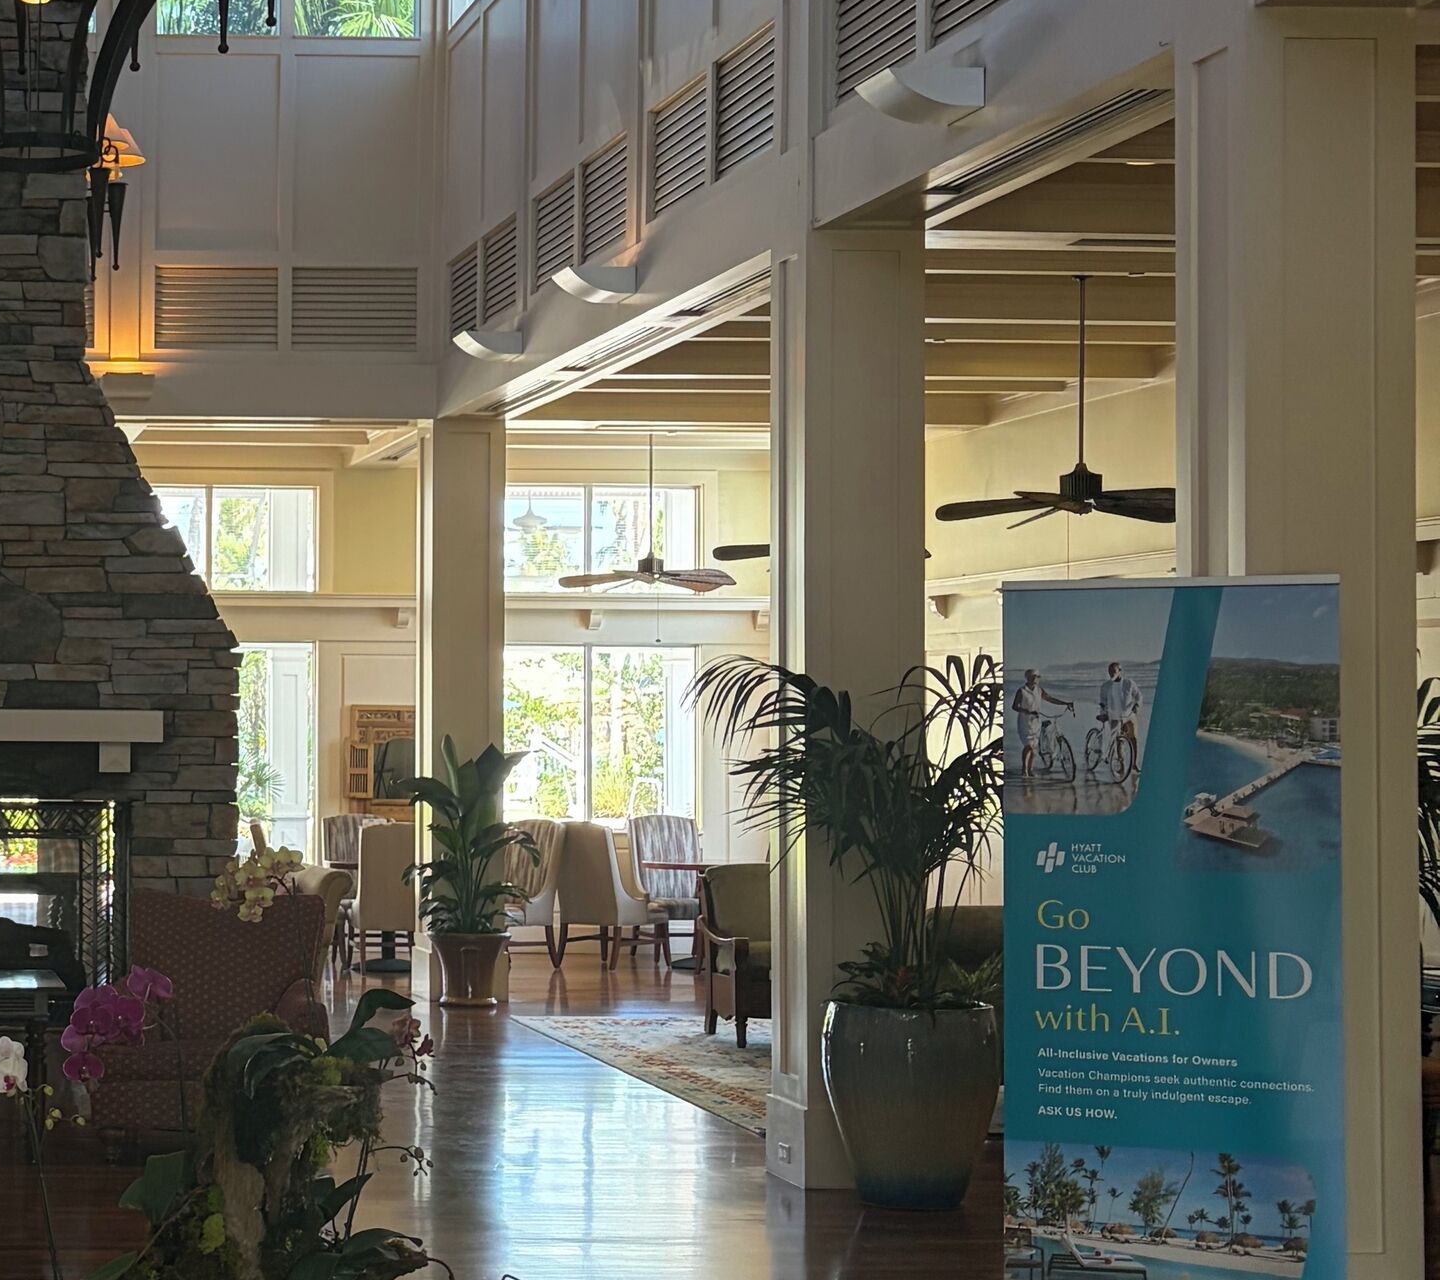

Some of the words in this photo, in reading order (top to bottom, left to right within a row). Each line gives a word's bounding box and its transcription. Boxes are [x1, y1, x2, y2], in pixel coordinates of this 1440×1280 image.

[1071, 843, 1101, 852] HYATT
[1071, 854, 1125, 863] VACATION
[1071, 864, 1097, 873] CLUB
[1037, 900, 1089, 929] Go
[1036, 944, 1312, 999] BEYOND
[1035, 1004, 1109, 1032] with
[1121, 1007, 1179, 1035] A.I.
[1038, 1048, 1109, 1060] All-Inclusive
[1112, 1052, 1168, 1063] Vacations
[1172, 1054, 1189, 1064] for
[1192, 1056, 1238, 1067] Owners
[1038, 1069, 1085, 1079] Vacation
[1089, 1070, 1150, 1084] Champions
[1154, 1074, 1180, 1084] seek
[1183, 1075, 1237, 1088] authentic
[1240, 1079, 1314, 1092] connections.
[1038, 1084, 1061, 1093] Find
[1065, 1086, 1093, 1095] them
[1096, 1088, 1110, 1096] on
[1113, 1089, 1120, 1097] a
[1123, 1089, 1148, 1100] truly
[1151, 1090, 1204, 1104] indulgent
[1208, 1093, 1251, 1105] escape.
[1038, 1106, 1062, 1115] ASK
[1066, 1107, 1082, 1117] US
[1086, 1109, 1117, 1119] HOW.
